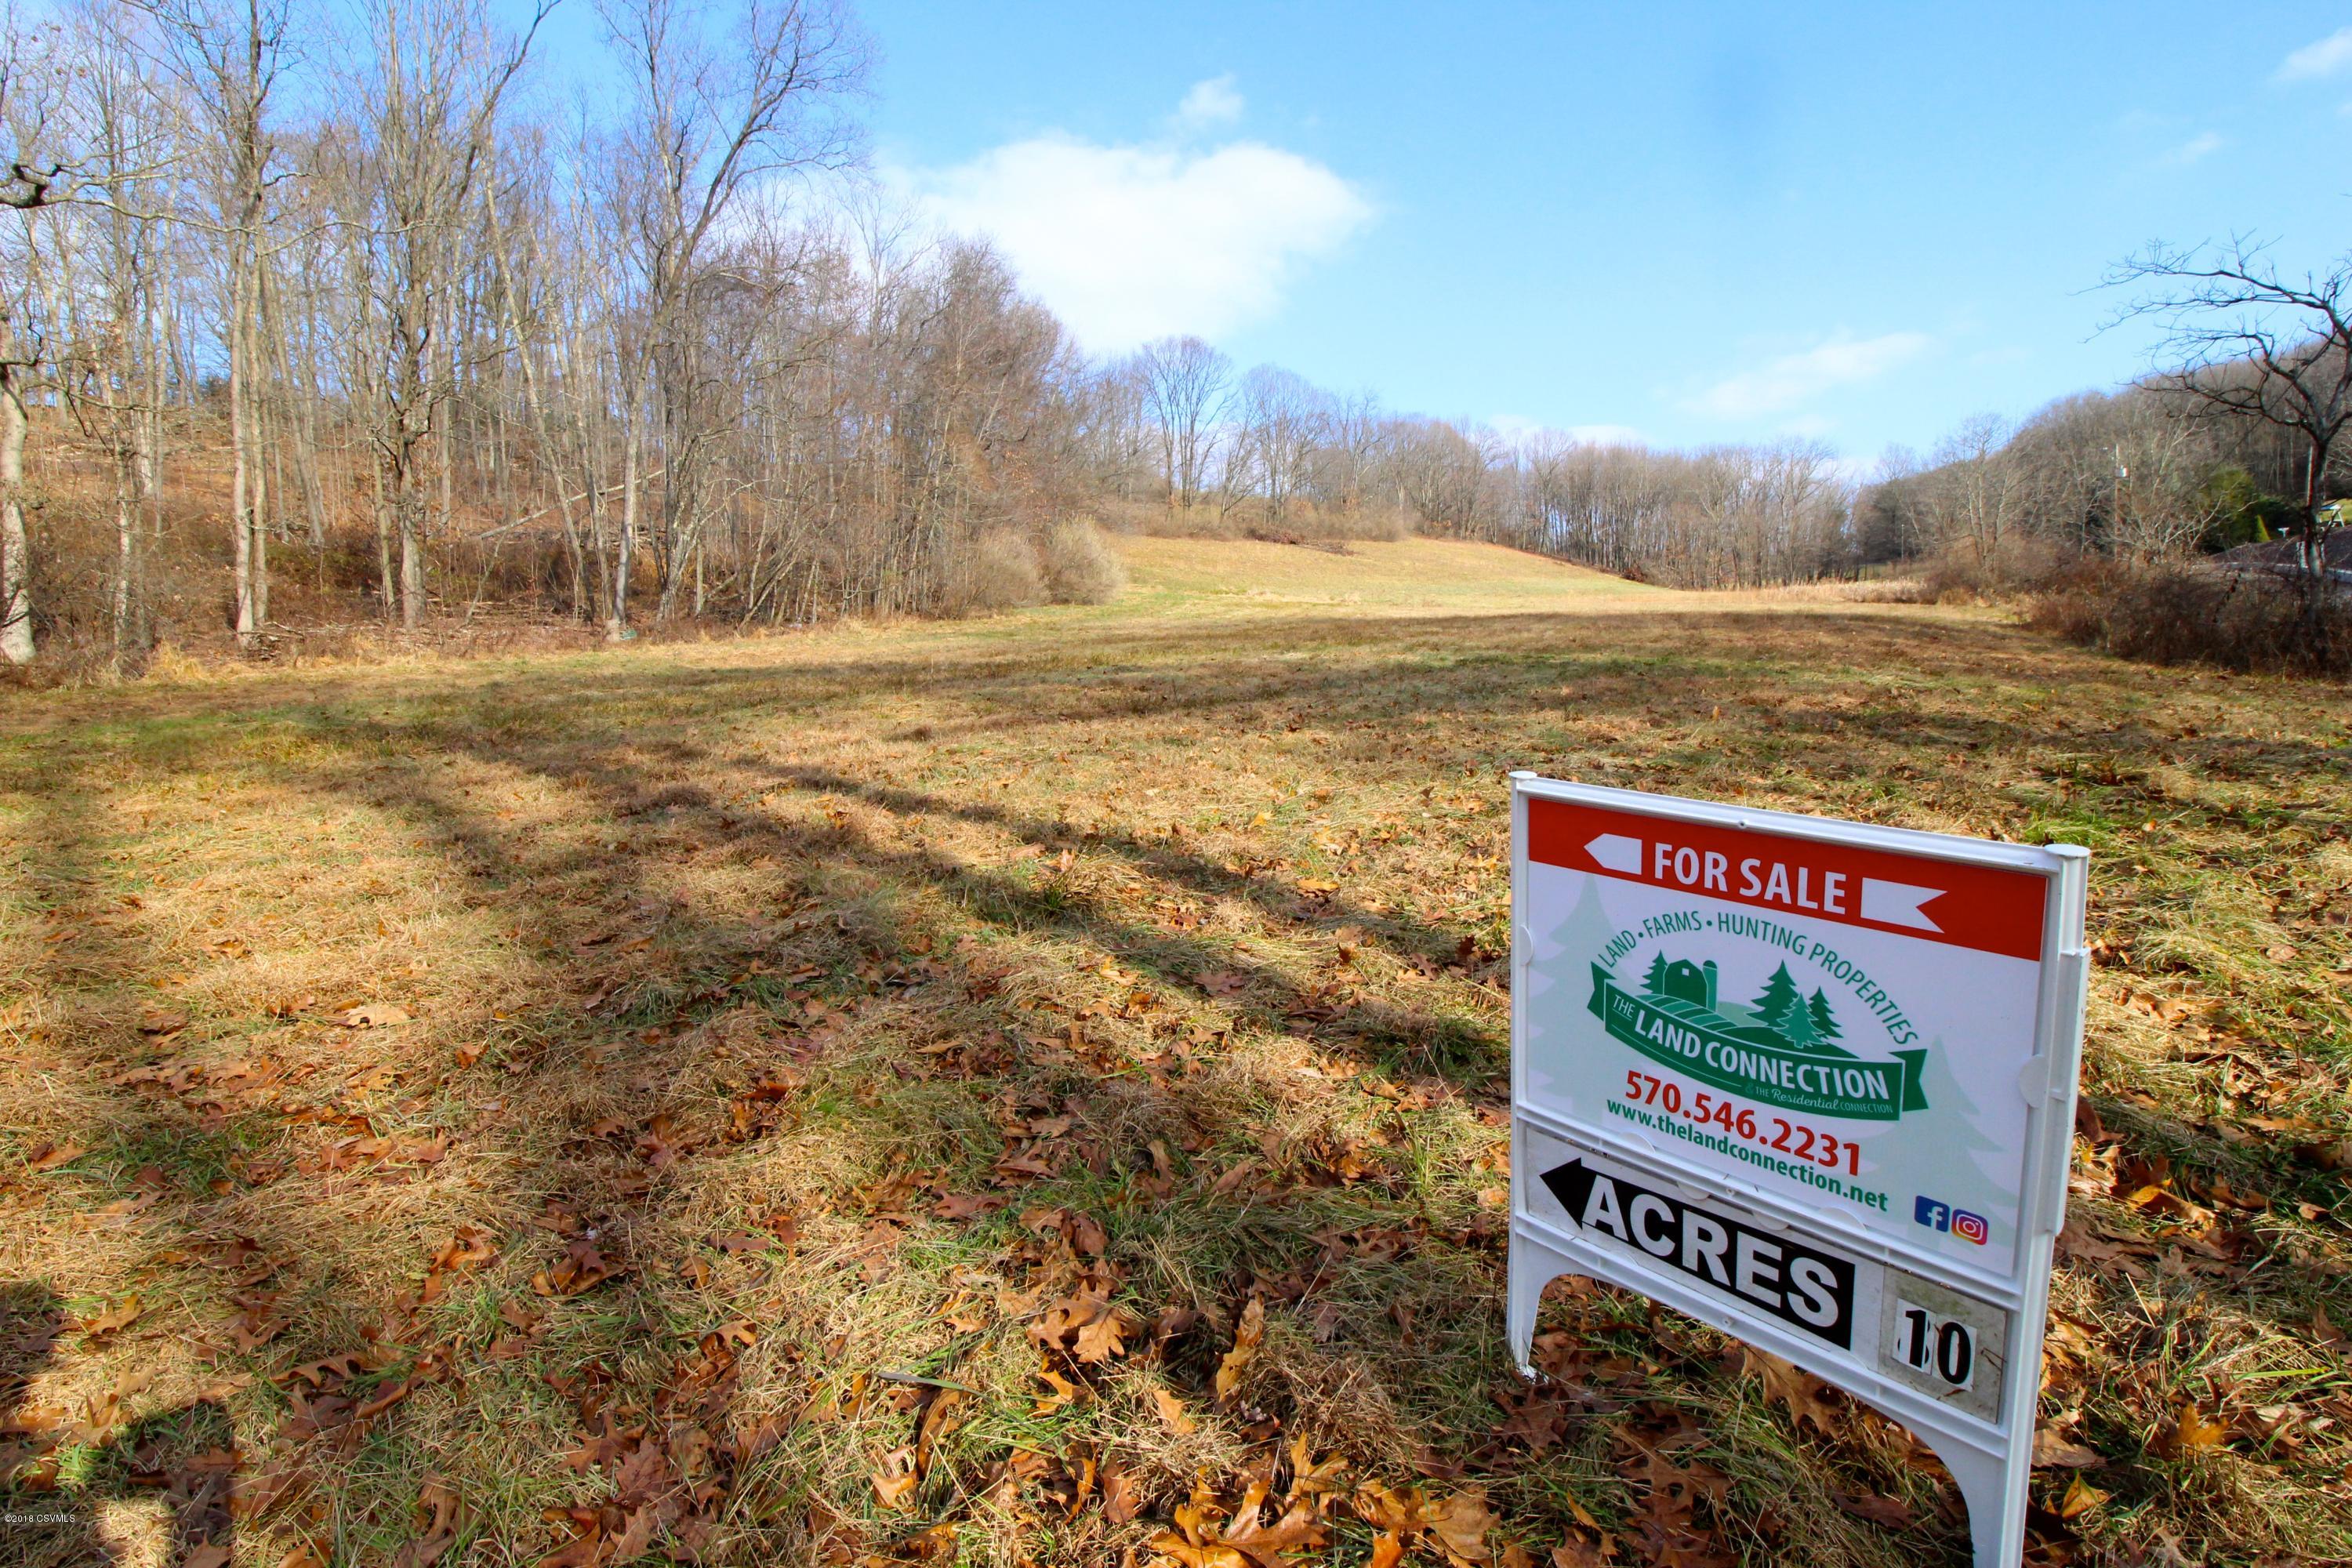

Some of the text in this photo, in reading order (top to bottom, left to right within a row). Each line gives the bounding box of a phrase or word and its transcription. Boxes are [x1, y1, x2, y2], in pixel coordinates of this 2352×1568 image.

[1655, 842, 1846, 915] FOR SALE
[1598, 910, 1918, 1045] LAND FARMS HUNTING PROPERTIES
[1613, 994, 1890, 1100] THE LAND CONNECTION
[1755, 1086, 1769, 1097] THE
[1771, 1088, 1840, 1110] Residential
[1840, 1101, 1893, 1113] CONNECTION
[1606, 1098, 1889, 1212] www.thelandconnection.net
[1625, 1070, 1860, 1176] 570.546.2231
[1581, 1174, 1838, 1328] ACRES
[1905, 1309, 1971, 1385] 10
